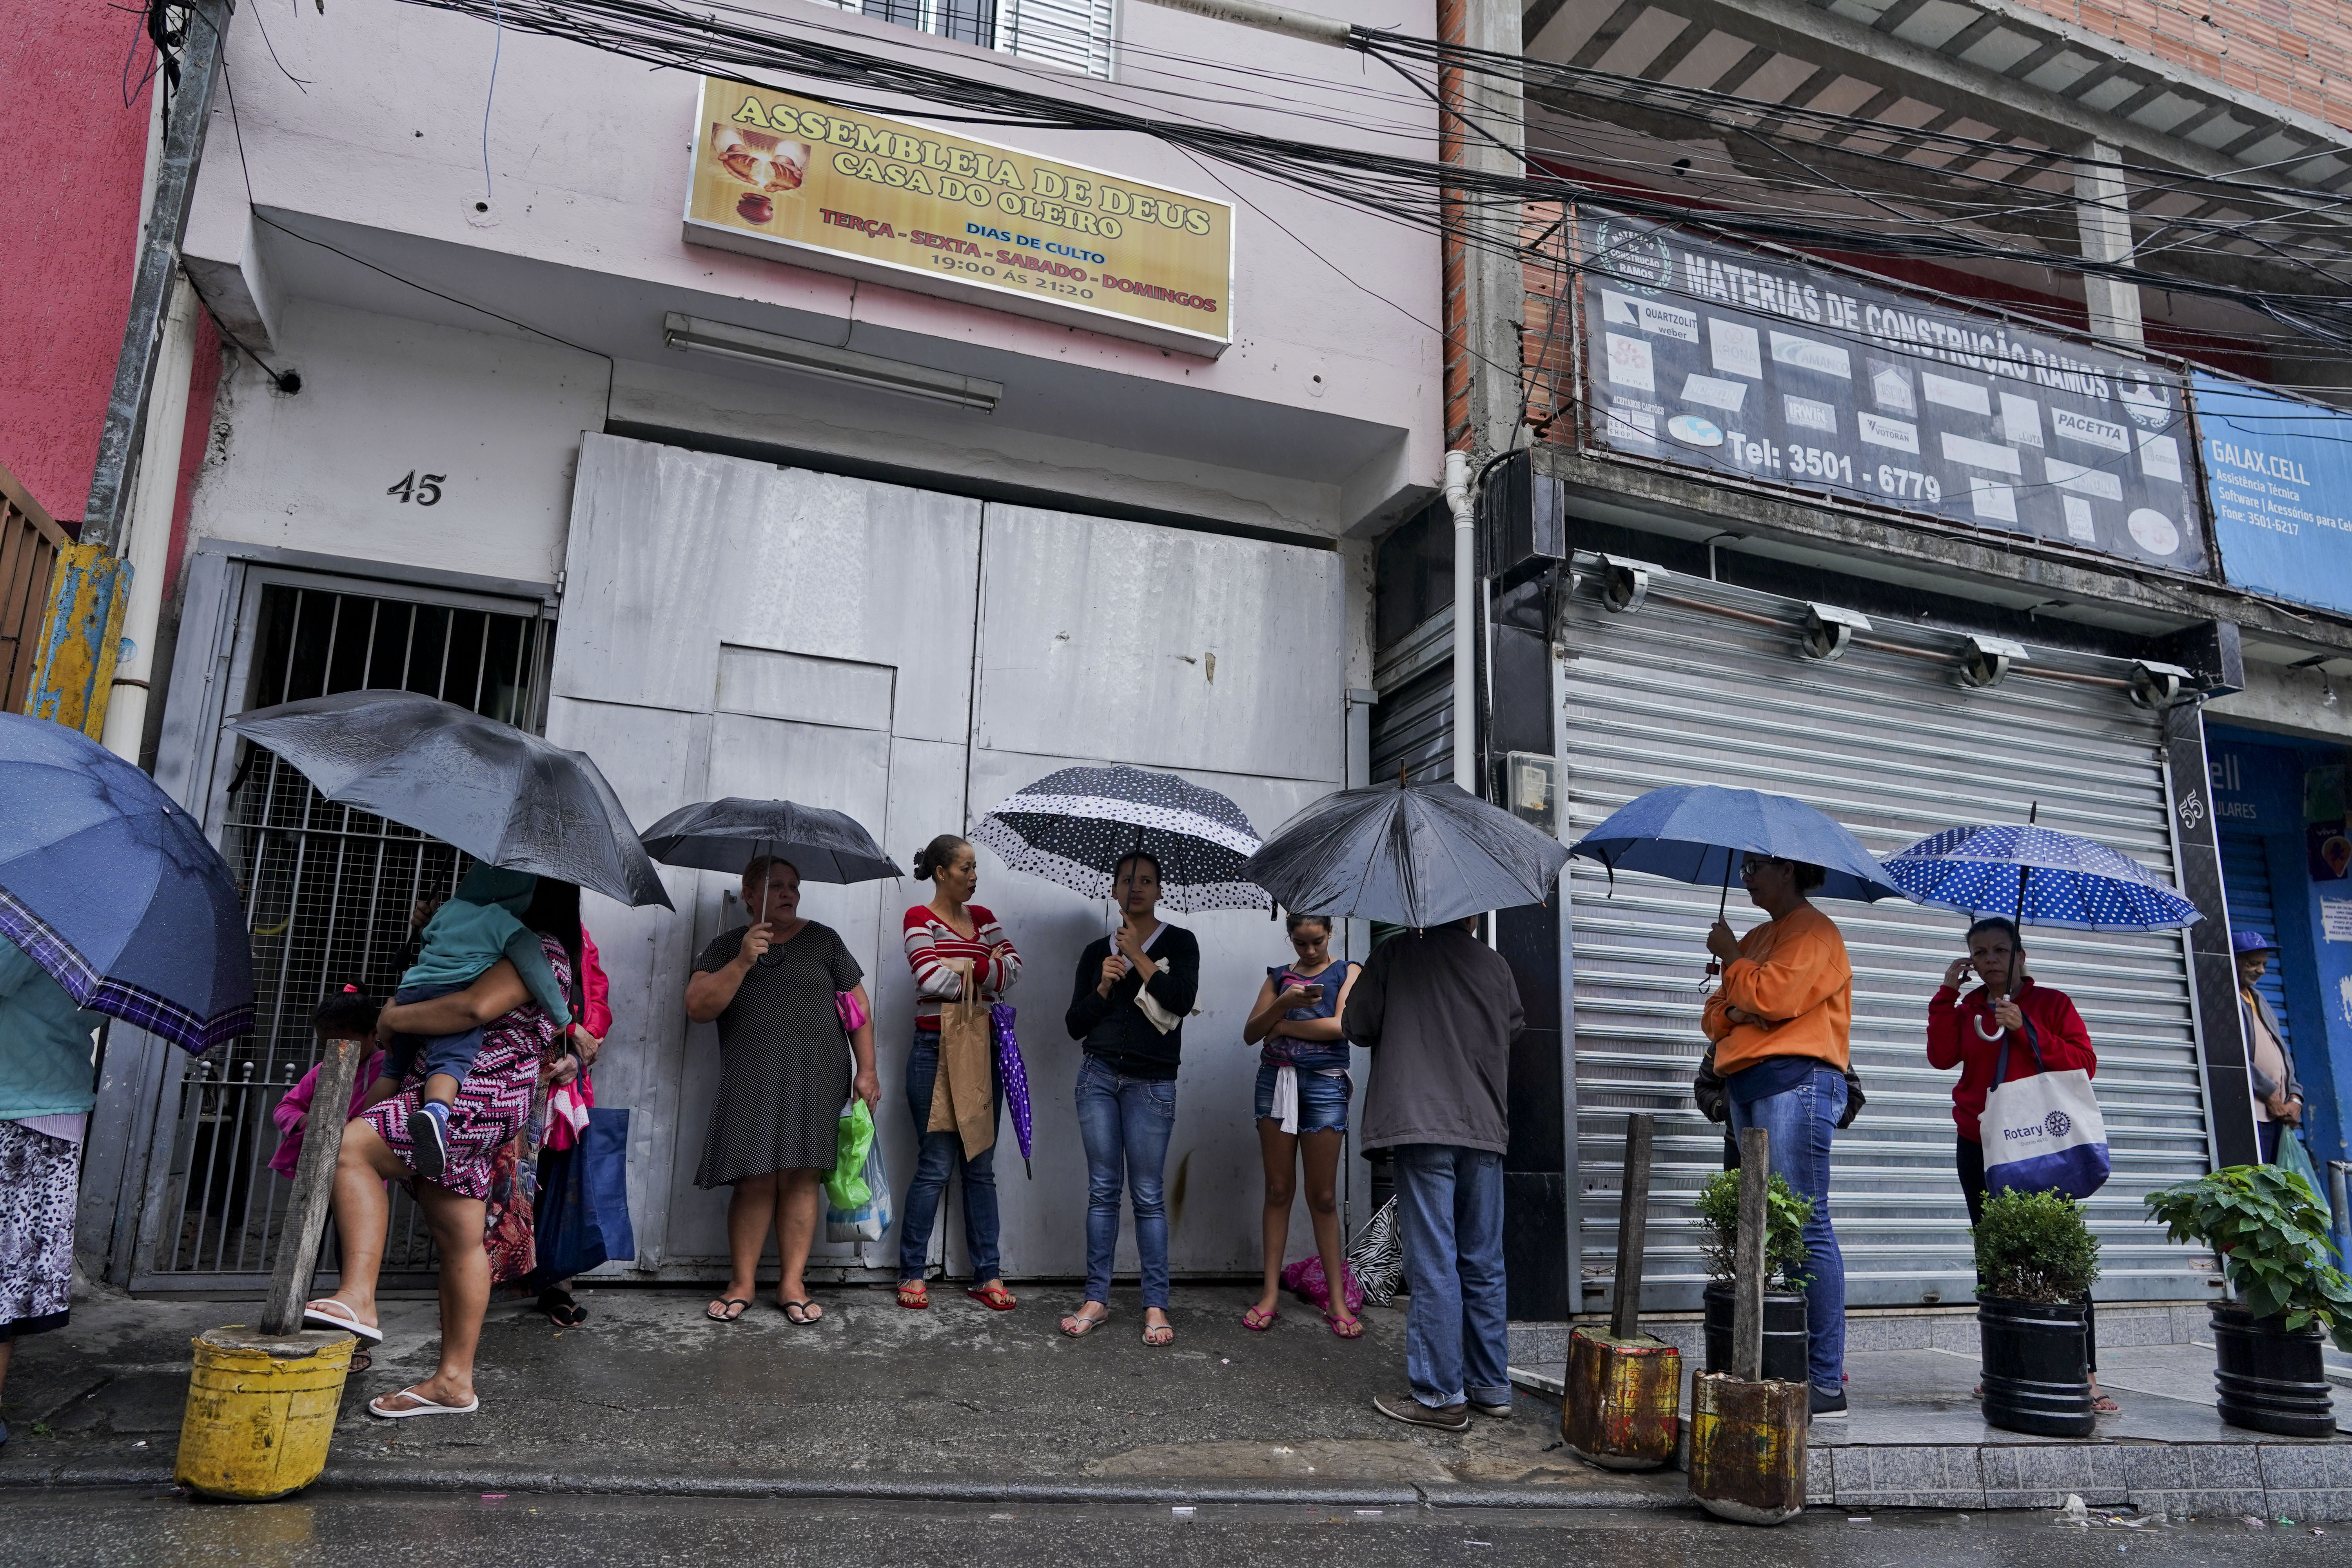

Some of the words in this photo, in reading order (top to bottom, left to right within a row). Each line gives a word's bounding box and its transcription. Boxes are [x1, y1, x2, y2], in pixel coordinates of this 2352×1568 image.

[731, 96, 1025, 191] ASSEMBLEIA
[1033, 168, 1092, 207] DE
[1099, 185, 1210, 235] DEUS
[833, 152, 933, 195] CASA
[938, 176, 991, 207] DO
[997, 192, 1122, 239] OLEIRO
[966, 221, 1011, 242] DIAS
[1015, 234, 1041, 250] DE
[1045, 241, 1105, 264] CULTO
[1629, 244, 1640, 254] DE
[819, 208, 895, 238] TERÇA
[910, 230, 982, 258] SEXTA
[996, 249, 1087, 282] SABADO
[1102, 274, 1217, 313] DOMINGOS
[1610, 249, 1660, 268] CONSTRUÇÃO
[931, 254, 996, 276] 19:00
[1002, 270, 1027, 284] ÁS
[1036, 278, 1094, 300] 21:20
[1619, 263, 1654, 279] RAMOS
[1646, 307, 1697, 328] QUARTZOLIT
[1684, 252, 1820, 322] MATERIAS
[1826, 290, 1861, 336] DE
[1866, 303, 2028, 381] CONSTRUÇÃO
[2032, 348, 2109, 402] RAMOS
[1659, 326, 1687, 339] weber
[1715, 342, 1757, 364] KRONA
[1801, 354, 1849, 373] AMANCO
[1613, 395, 1641, 410] ACEITAMOS
[1641, 403, 1664, 415] CARTÕES
[1789, 402, 1826, 423] IRWIN
[1609, 421, 1631, 431] REDE
[1637, 416, 1651, 424] VISA
[2058, 413, 2121, 440] PACETTA
[1609, 429, 1631, 437] SHOP
[1875, 427, 1909, 443] VOTORAN
[2011, 428, 2042, 446] LLOTA
[1727, 430, 1781, 469] Tel:
[1788, 444, 1853, 484] 3501
[1878, 464, 1942, 503] 6779
[2212, 439, 2310, 486] GALAX.CELL
[387, 469, 446, 506] 45
[2217, 468, 2266, 493] Assistência
[2267, 483, 2300, 502] Técnica
[2218, 486, 2259, 508] Software
[2268, 500, 2314, 523] Acessórios
[2316, 515, 2336, 528] para
[2338, 518, 2352, 532] Cel
[2221, 505, 2246, 522] Fone:
[2247, 511, 2299, 536] 3501-6217
[2178, 789, 2204, 829] 55
[2316, 828, 2338, 837] vivo
[2004, 1125, 2042, 1141] Rotary
